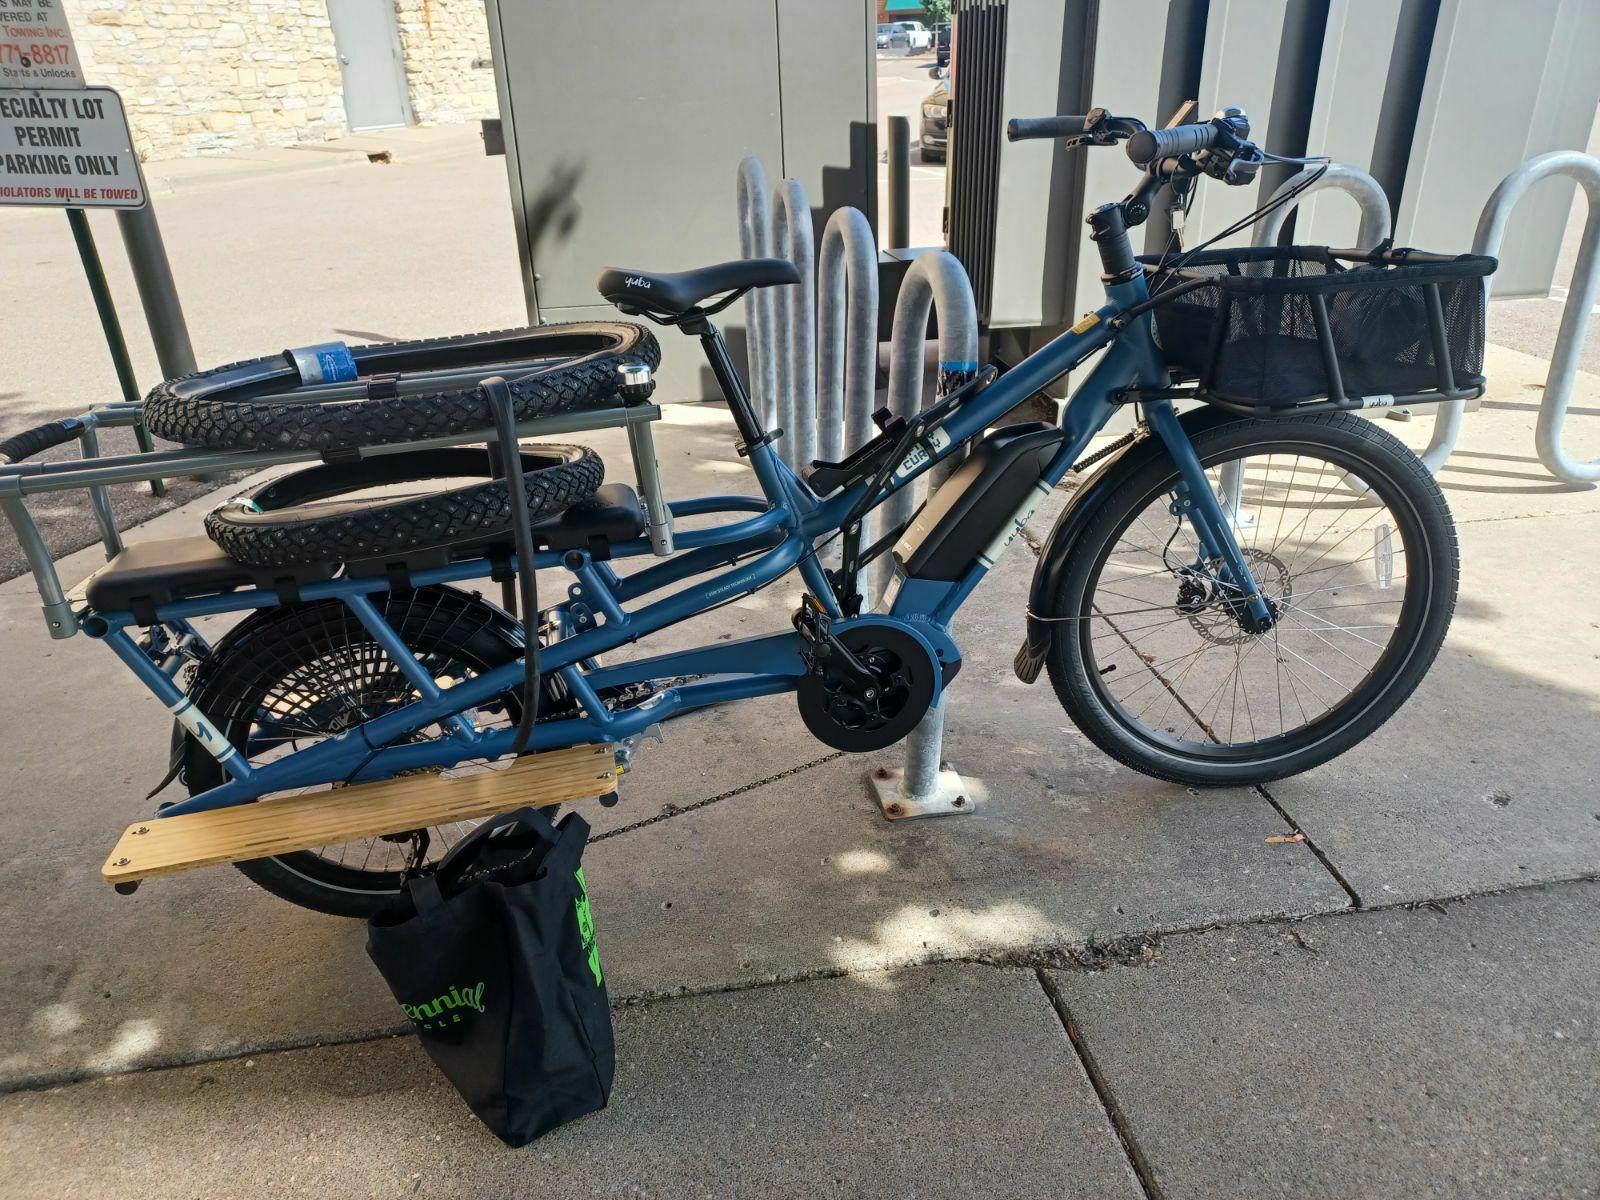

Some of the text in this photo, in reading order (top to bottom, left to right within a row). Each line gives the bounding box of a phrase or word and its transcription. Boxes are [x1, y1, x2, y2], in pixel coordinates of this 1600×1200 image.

[37, 12, 48, 22] AT
[40, 68, 77, 78] Unlocks
[72, 98, 105, 119] LOT
[14, 126, 82, 147] PERMIT
[74, 155, 119, 176] ONLY
[54, 187, 81, 198] WILL
[83, 188, 97, 199] BE
[100, 188, 138, 200] TOWED
[624, 276, 651, 289] yuba
